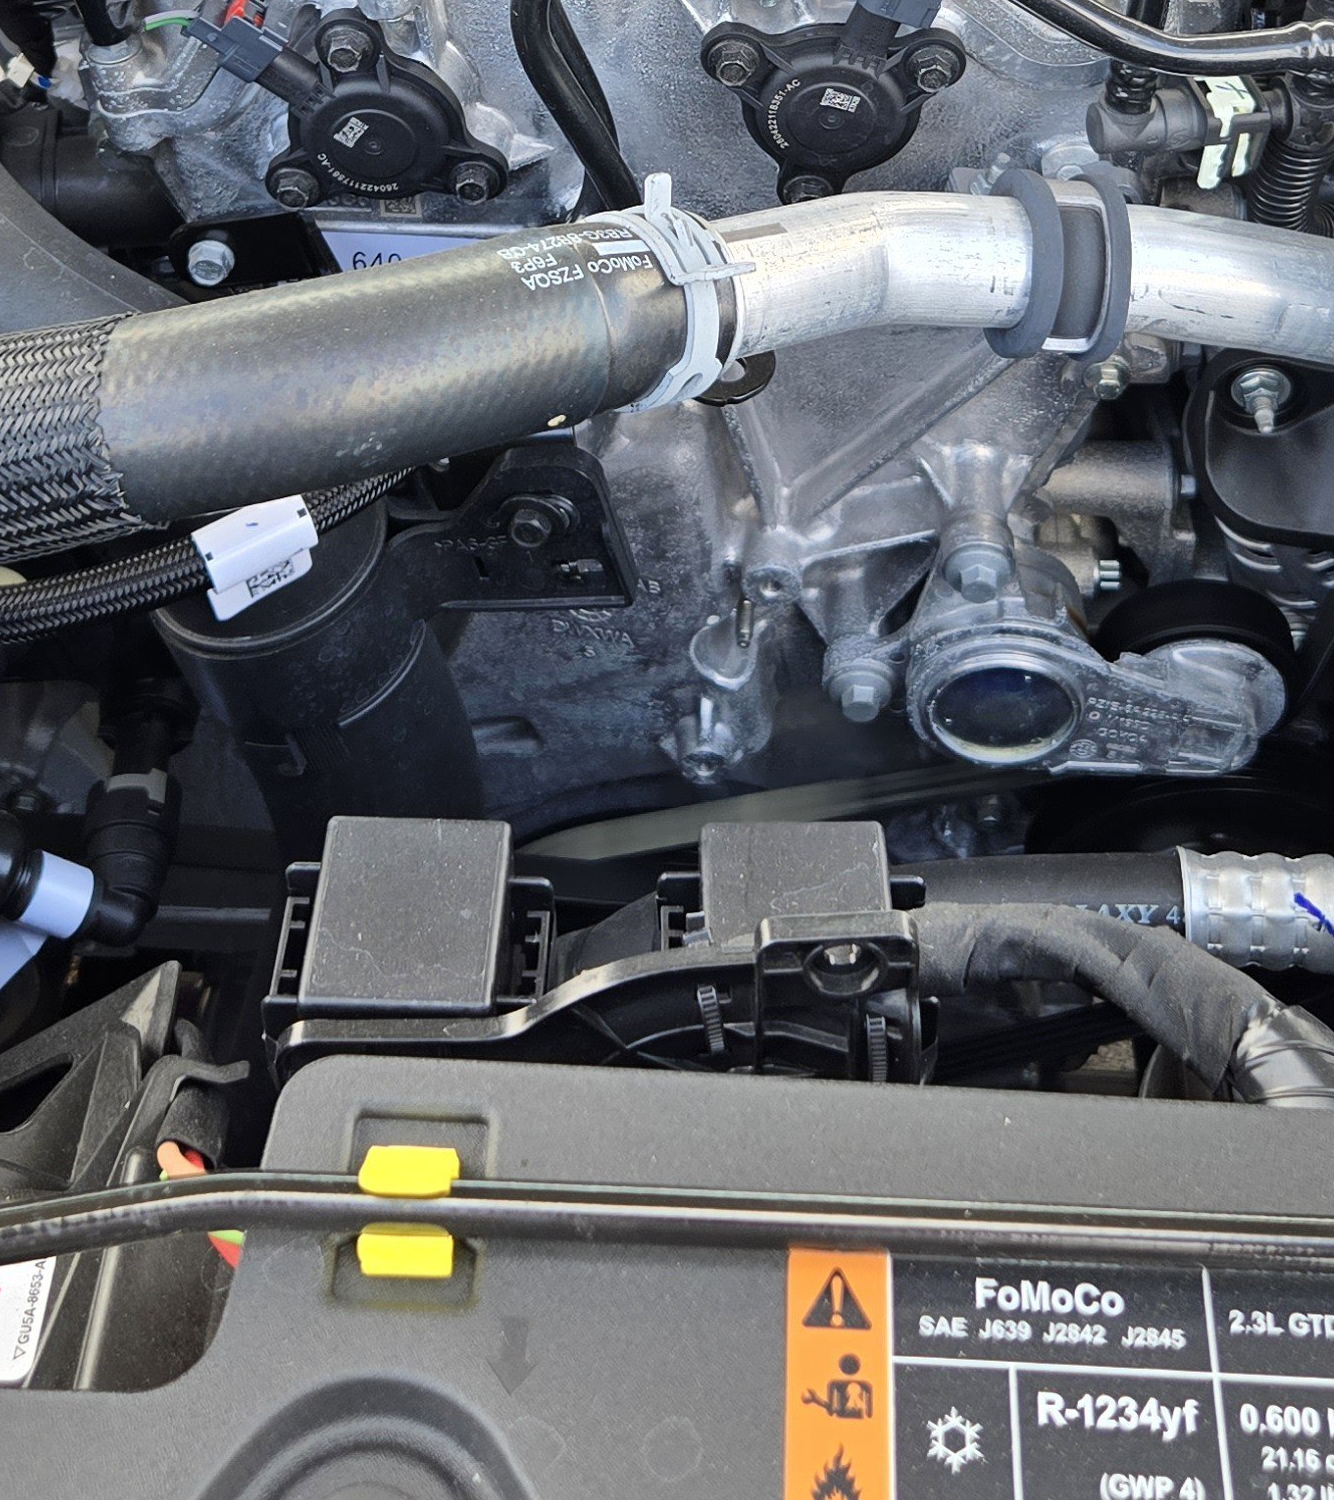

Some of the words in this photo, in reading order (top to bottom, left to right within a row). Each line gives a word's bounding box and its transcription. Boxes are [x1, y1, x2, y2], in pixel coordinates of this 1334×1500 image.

[510, 252, 558, 274] F6P3
[520, 263, 585, 291] FZSQA
[587, 254, 653, 275] FoMoCo
[975, 1276, 1125, 1317] FoMoCo
[918, 1314, 968, 1338] SAE
[977, 1317, 1033, 1342] J639
[1042, 1321, 1108, 1345] J2842
[1120, 1325, 1187, 1350] J2845
[1228, 1308, 1285, 1337] 2.3L
[1037, 1390, 1200, 1443] R-1234yf
[1239, 1403, 1321, 1438] 0.600
[1260, 1446, 1321, 1473] 21.16
[1099, 1472, 1175, 1500] (GWP
